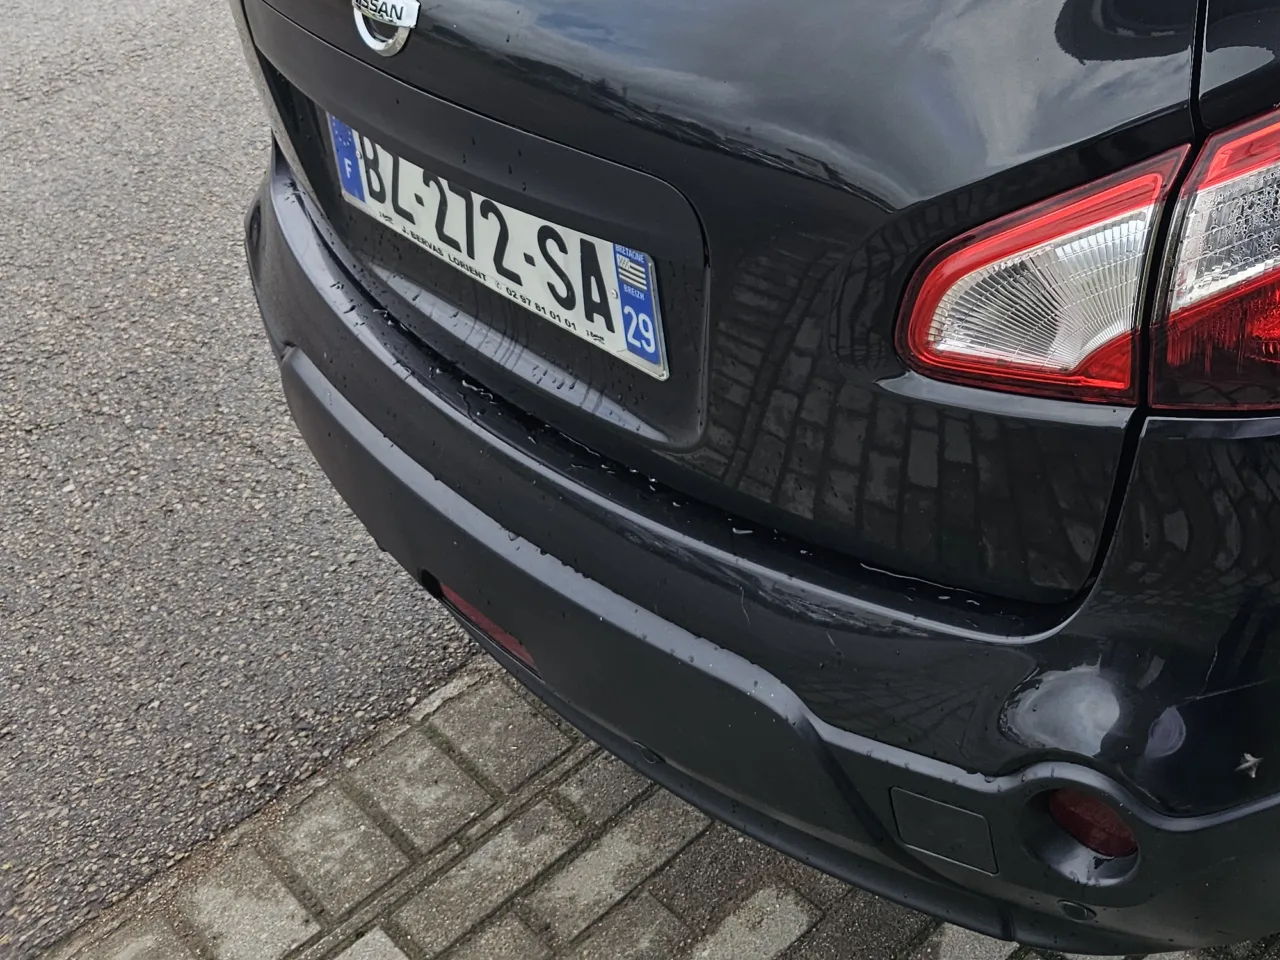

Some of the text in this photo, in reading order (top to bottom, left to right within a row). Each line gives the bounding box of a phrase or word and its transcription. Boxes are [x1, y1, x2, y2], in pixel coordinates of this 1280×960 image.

[343, 157, 353, 179] F
[615, 243, 645, 264] BRETAGNE
[410, 230, 444, 257] BERVAS
[448, 253, 487, 282] LORIENT
[506, 287, 518, 300] 02
[520, 294, 532, 307] 97
[549, 310, 561, 323] 01
[564, 318, 577, 331] 01
[623, 284, 645, 301] BREIZH
[623, 305, 656, 354] 29
